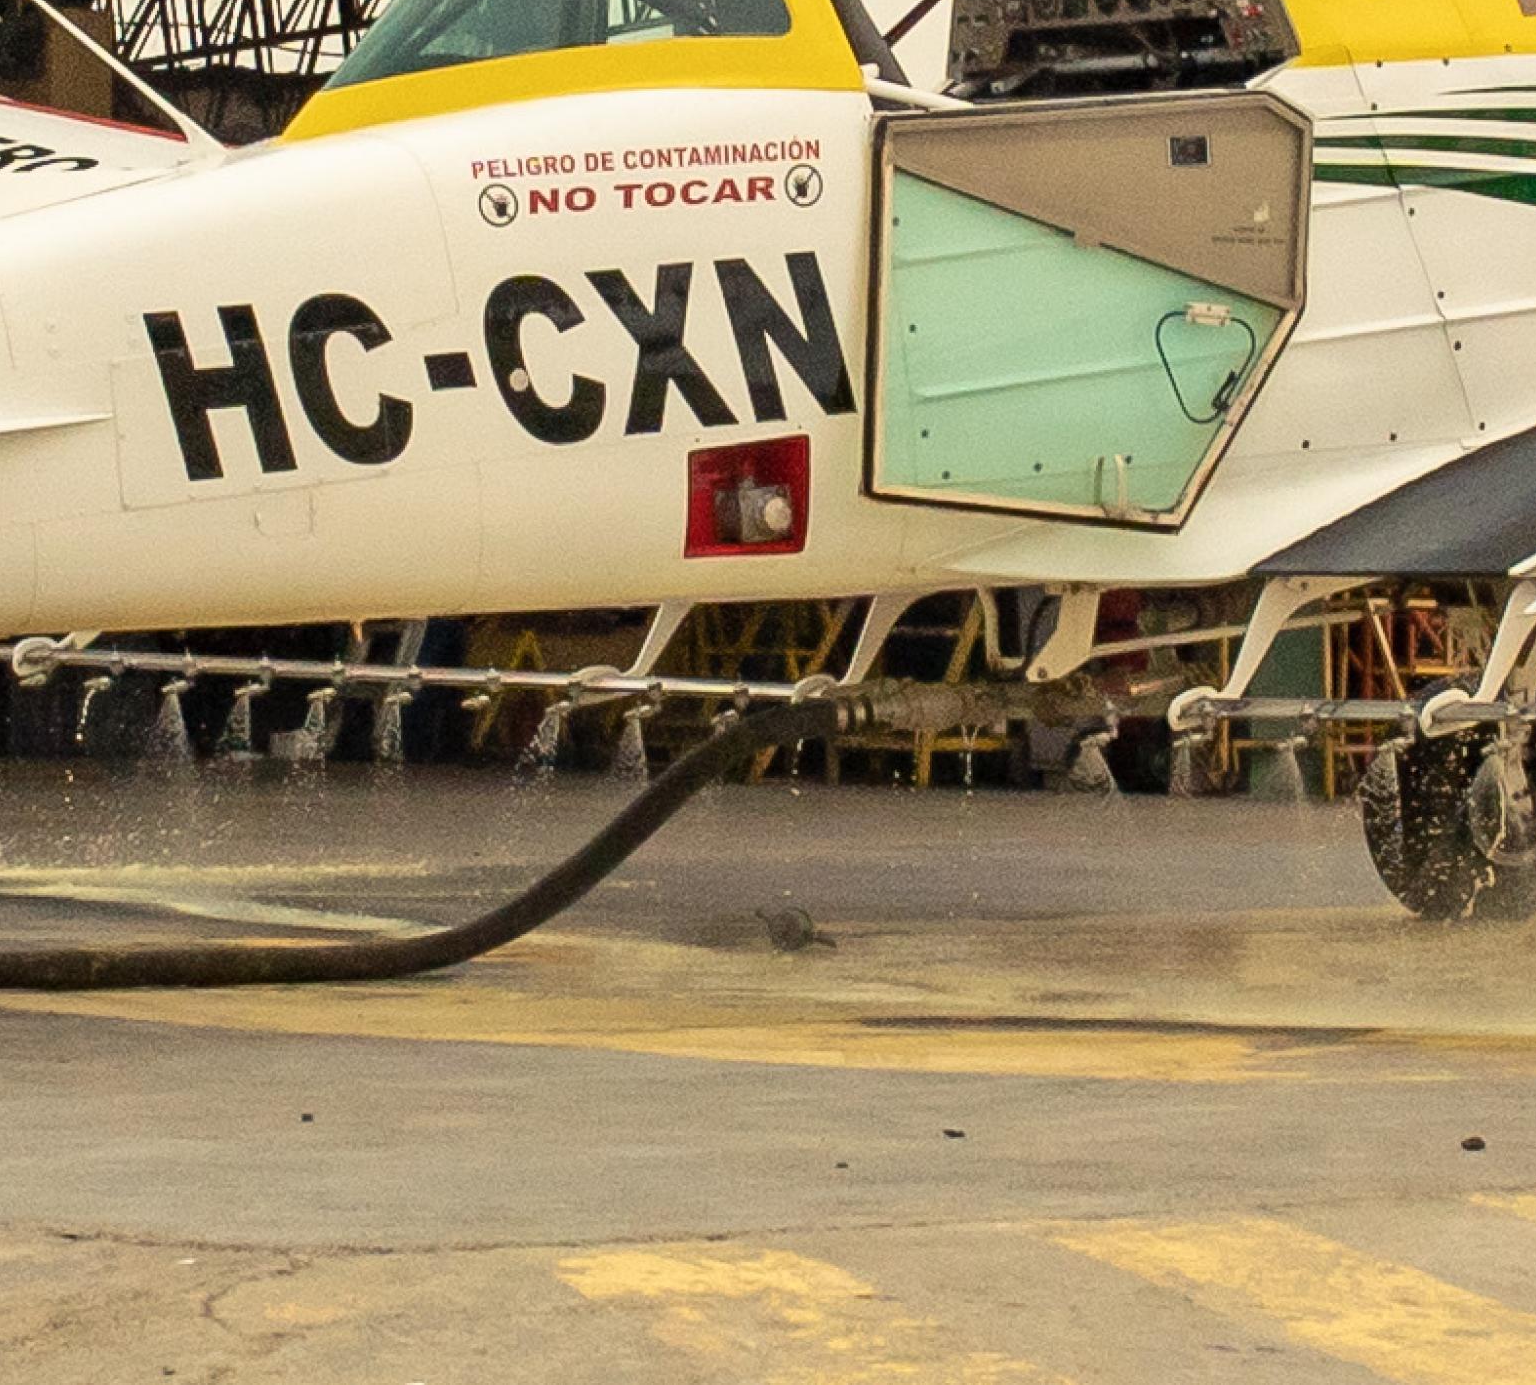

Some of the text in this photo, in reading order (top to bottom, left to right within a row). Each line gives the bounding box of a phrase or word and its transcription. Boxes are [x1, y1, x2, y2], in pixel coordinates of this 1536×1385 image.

[470, 134, 822, 180] PELIGRO DE CONTAMINACIÓN
[527, 175, 778, 215] NO TOCAR
[142, 251, 858, 482] HC-CXN
